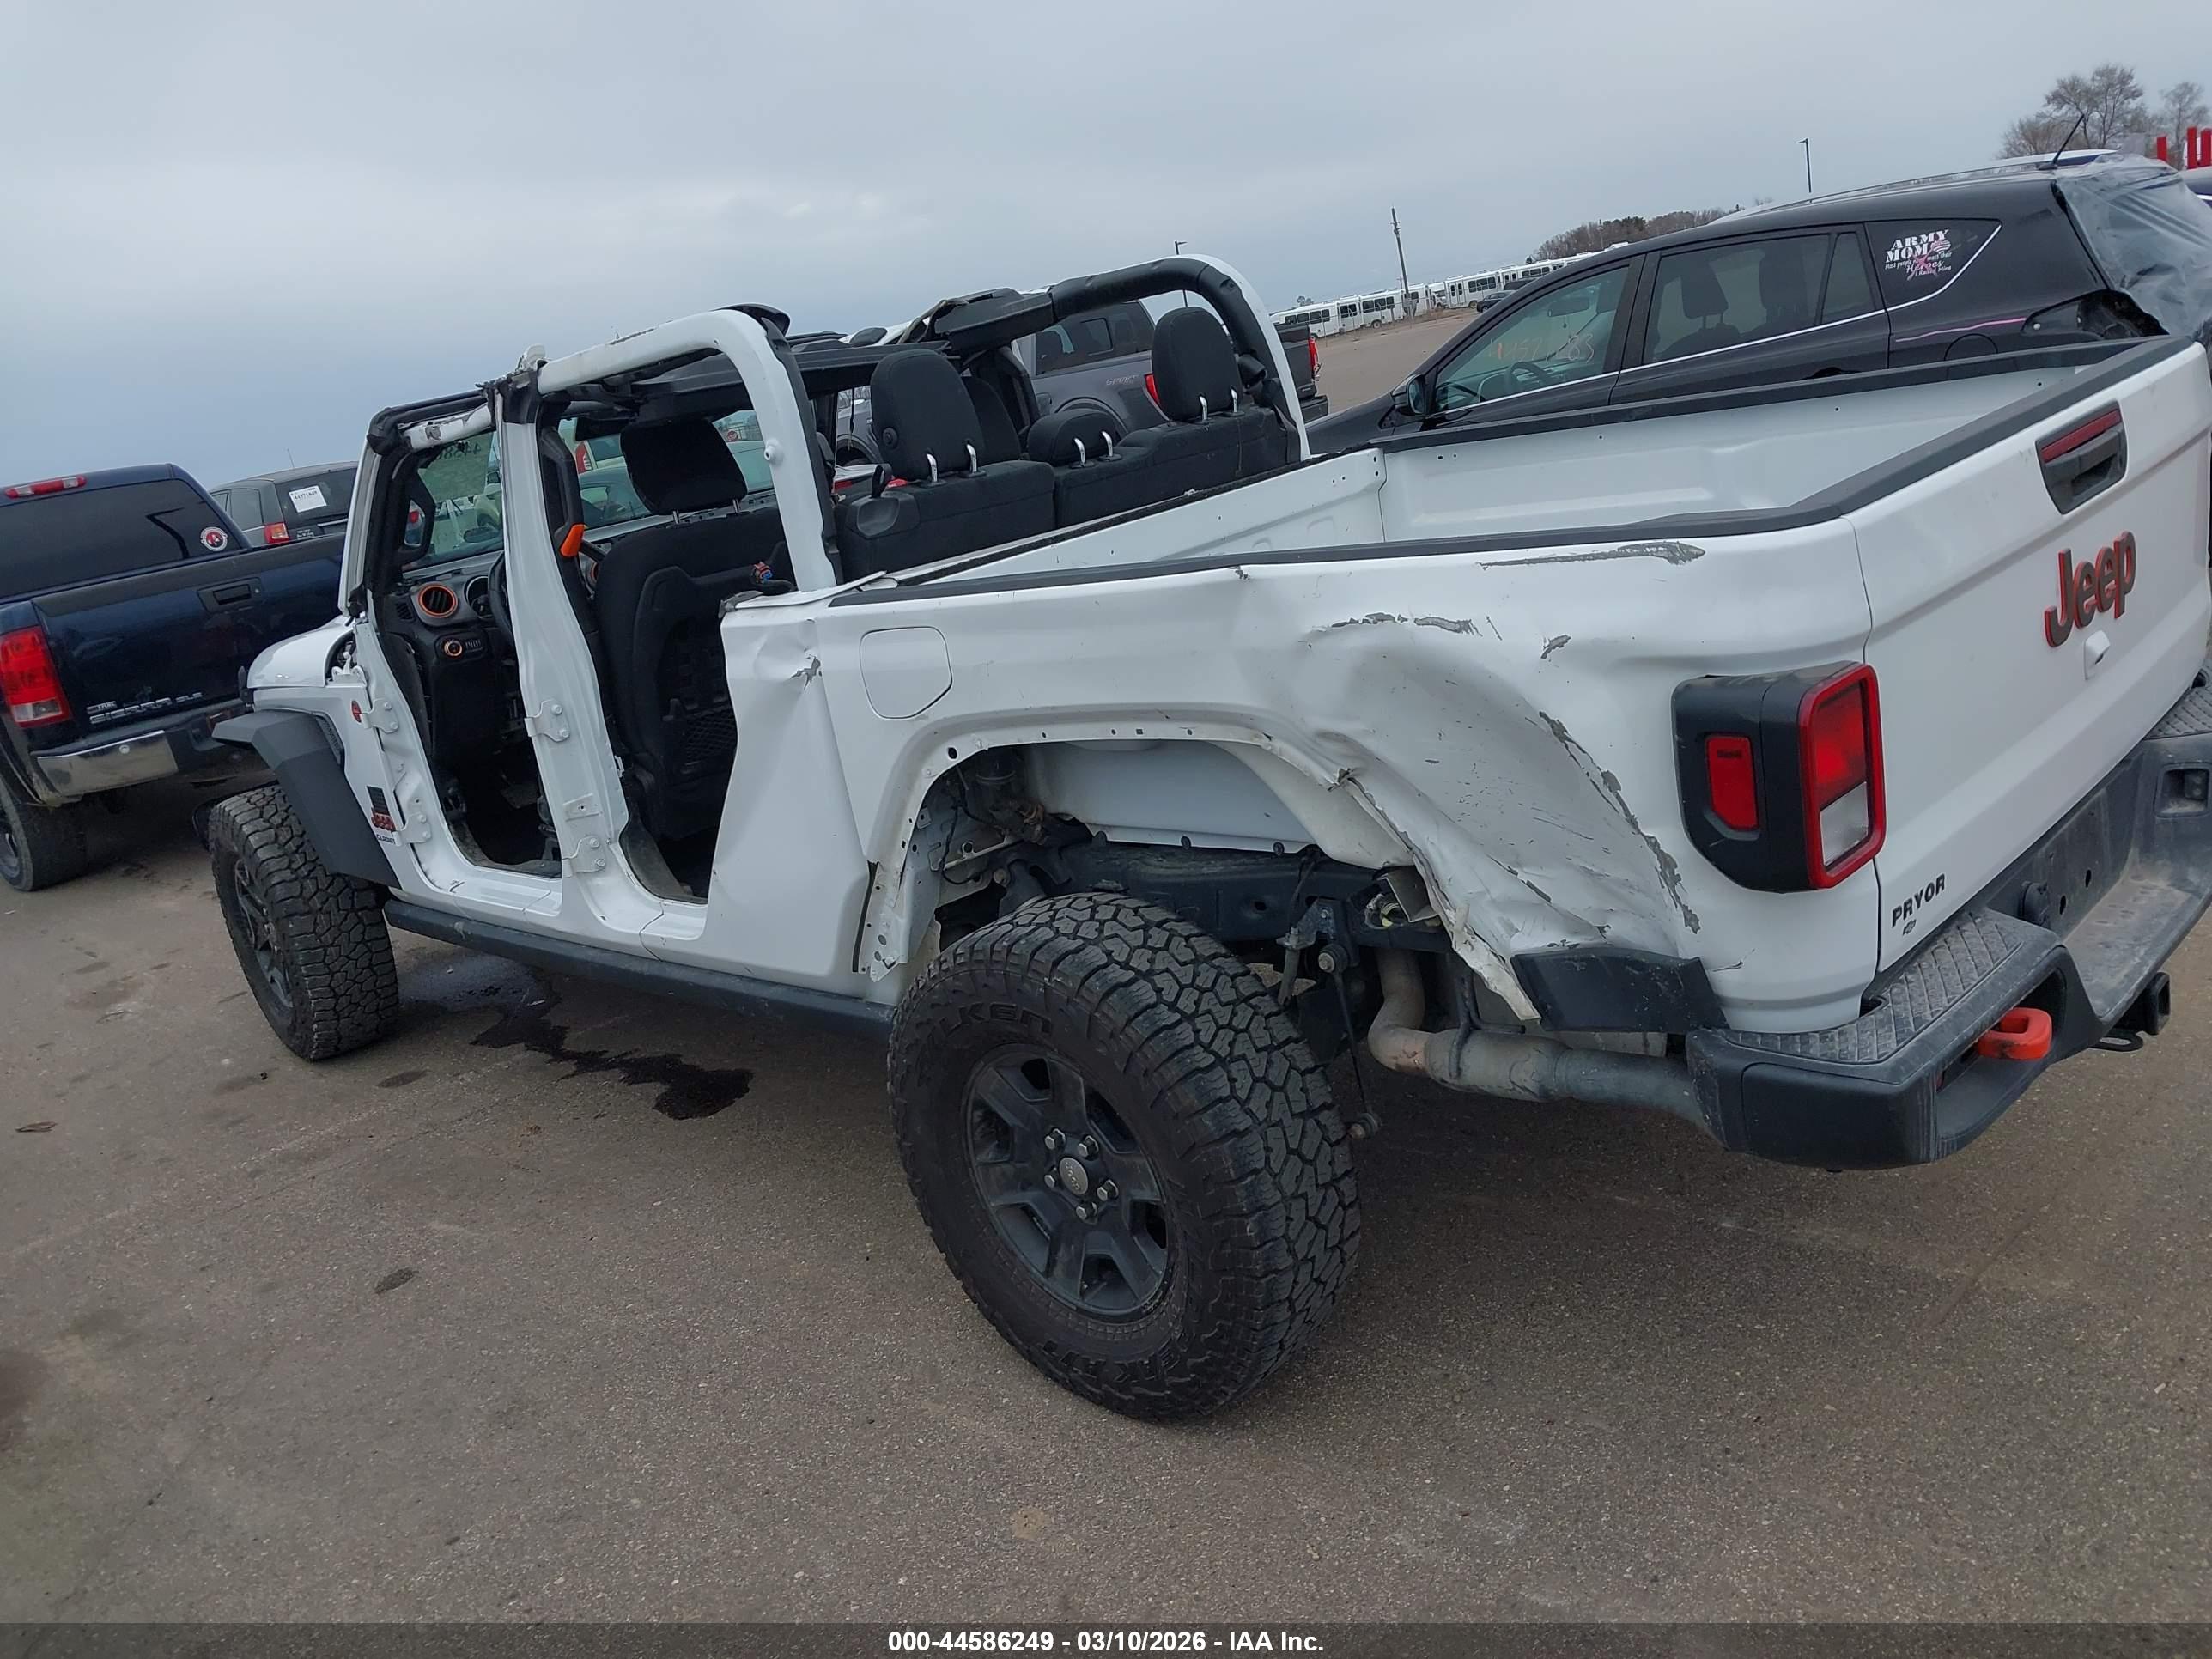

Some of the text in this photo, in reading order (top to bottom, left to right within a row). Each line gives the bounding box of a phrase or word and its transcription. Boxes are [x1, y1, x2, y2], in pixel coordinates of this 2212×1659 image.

[1890, 228, 1949, 250] ARMY
[1885, 243, 1929, 263] MOM
[2044, 531, 2136, 647] Jeep
[89, 697, 173, 724] SIERRA
[1892, 873, 1945, 928] PRYOR
